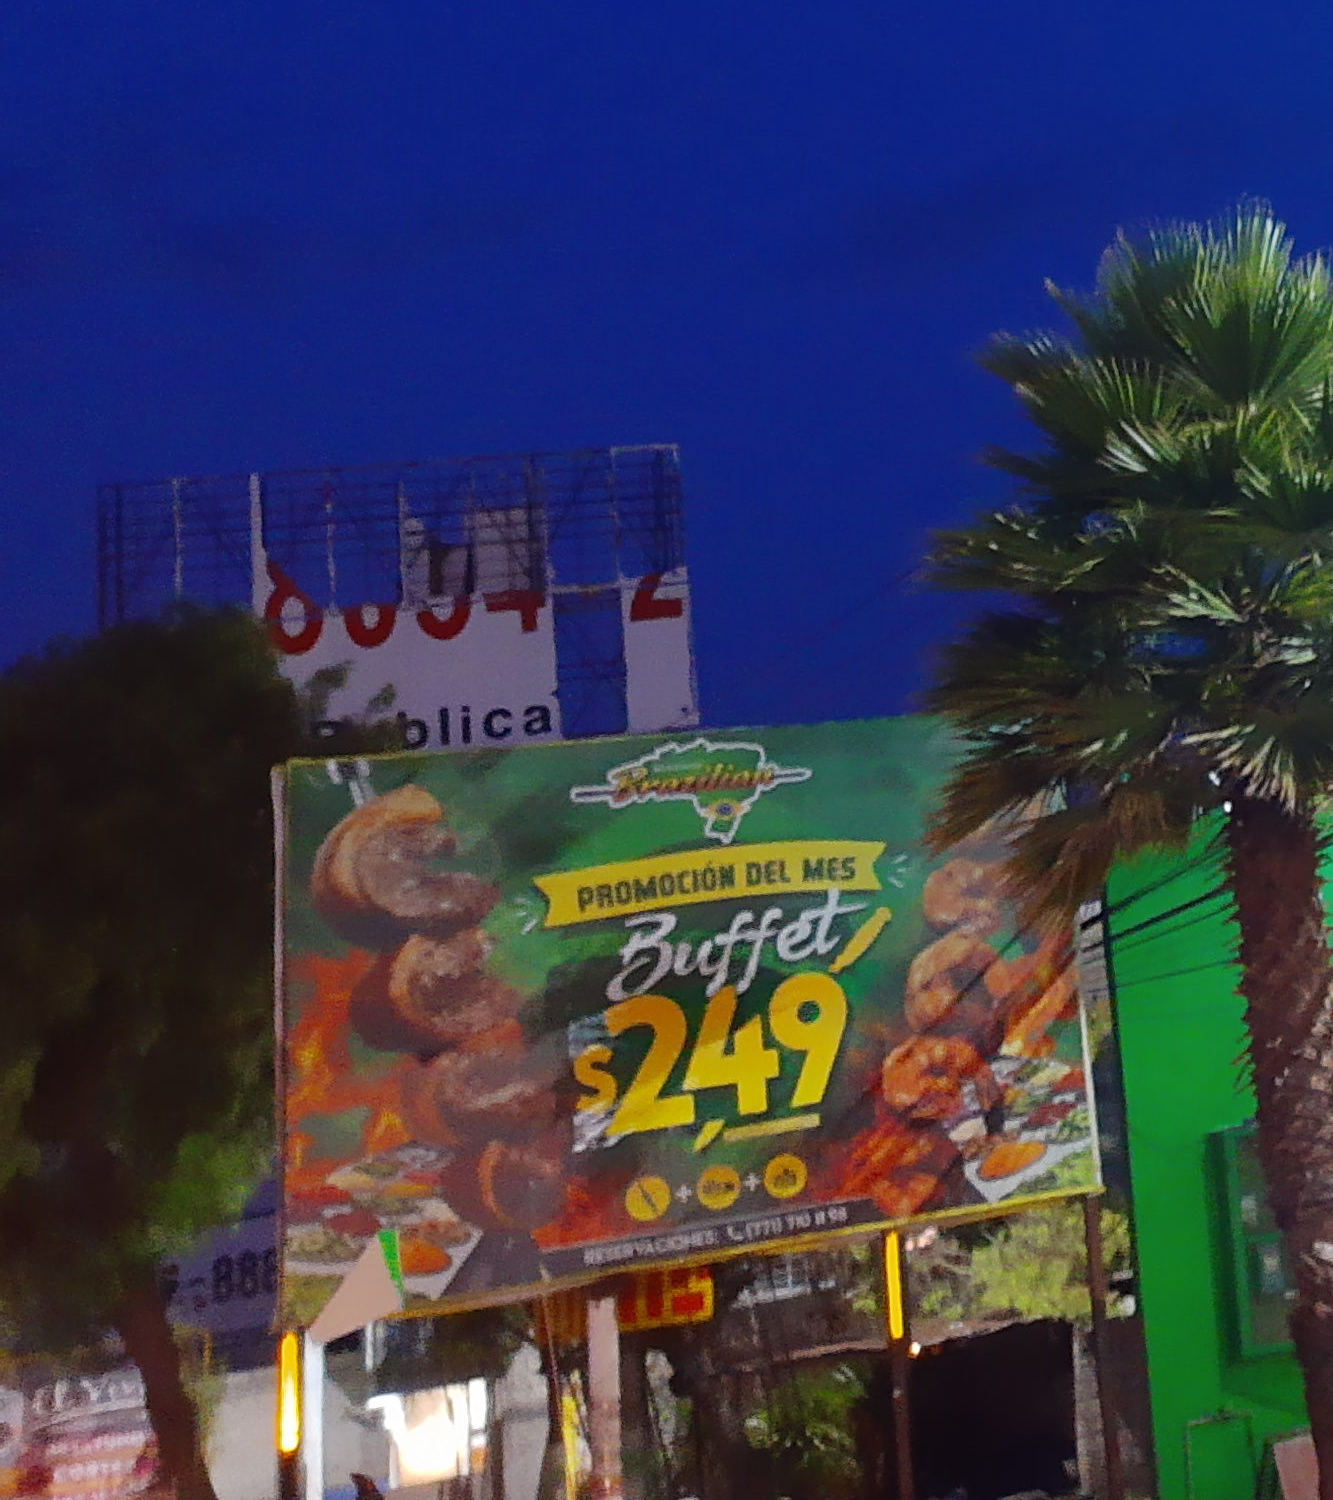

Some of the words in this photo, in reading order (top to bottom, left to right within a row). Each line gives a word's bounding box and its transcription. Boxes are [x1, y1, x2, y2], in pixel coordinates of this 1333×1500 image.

[577, 861, 735, 912] PROMOCIÓN
[745, 859, 791, 886] DEL
[802, 856, 857, 883] MES
[605, 889, 869, 1000] Buffet
